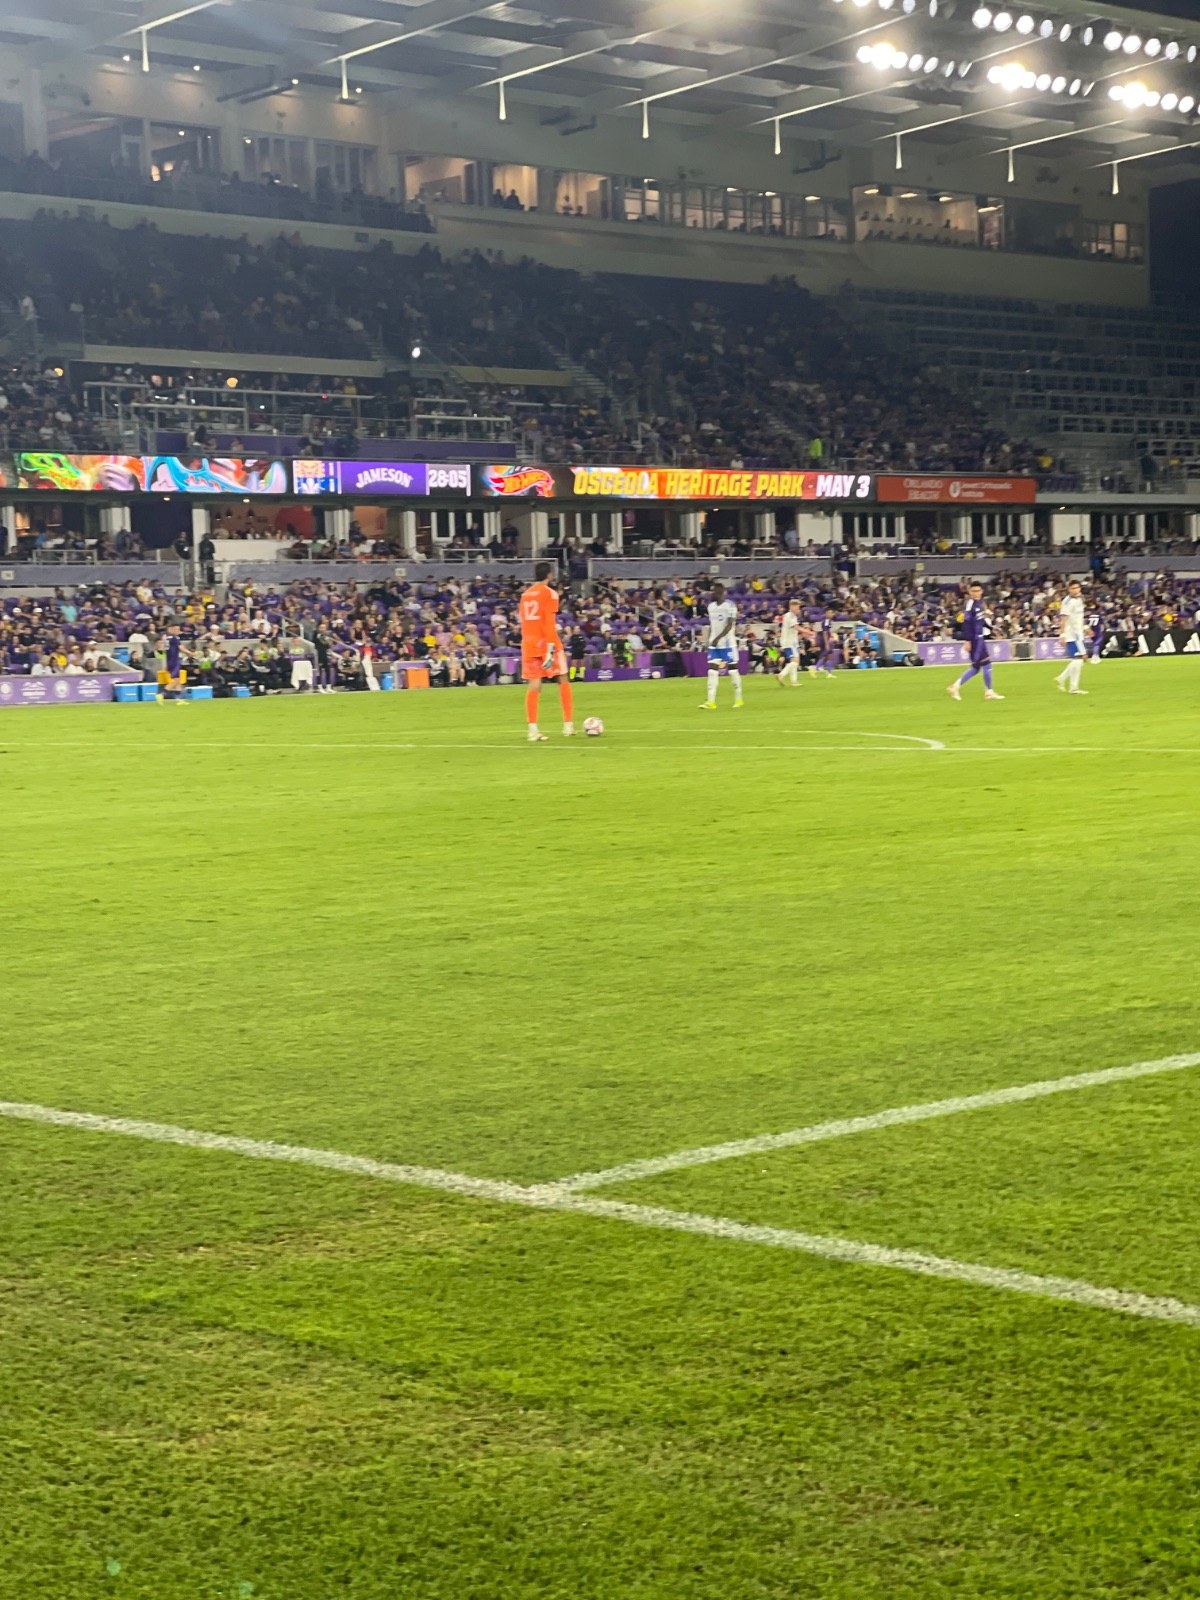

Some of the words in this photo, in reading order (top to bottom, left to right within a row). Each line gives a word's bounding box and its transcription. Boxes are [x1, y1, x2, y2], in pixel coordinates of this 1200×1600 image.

[356, 467, 412, 488] JAMESON
[573, 471, 658, 495] OSCEOLA
[665, 472, 753, 497] HERITAGE
[756, 474, 805, 497] PARK
[816, 474, 855, 497] MAY
[856, 475, 871, 498] 3
[524, 600, 540, 621] 12
